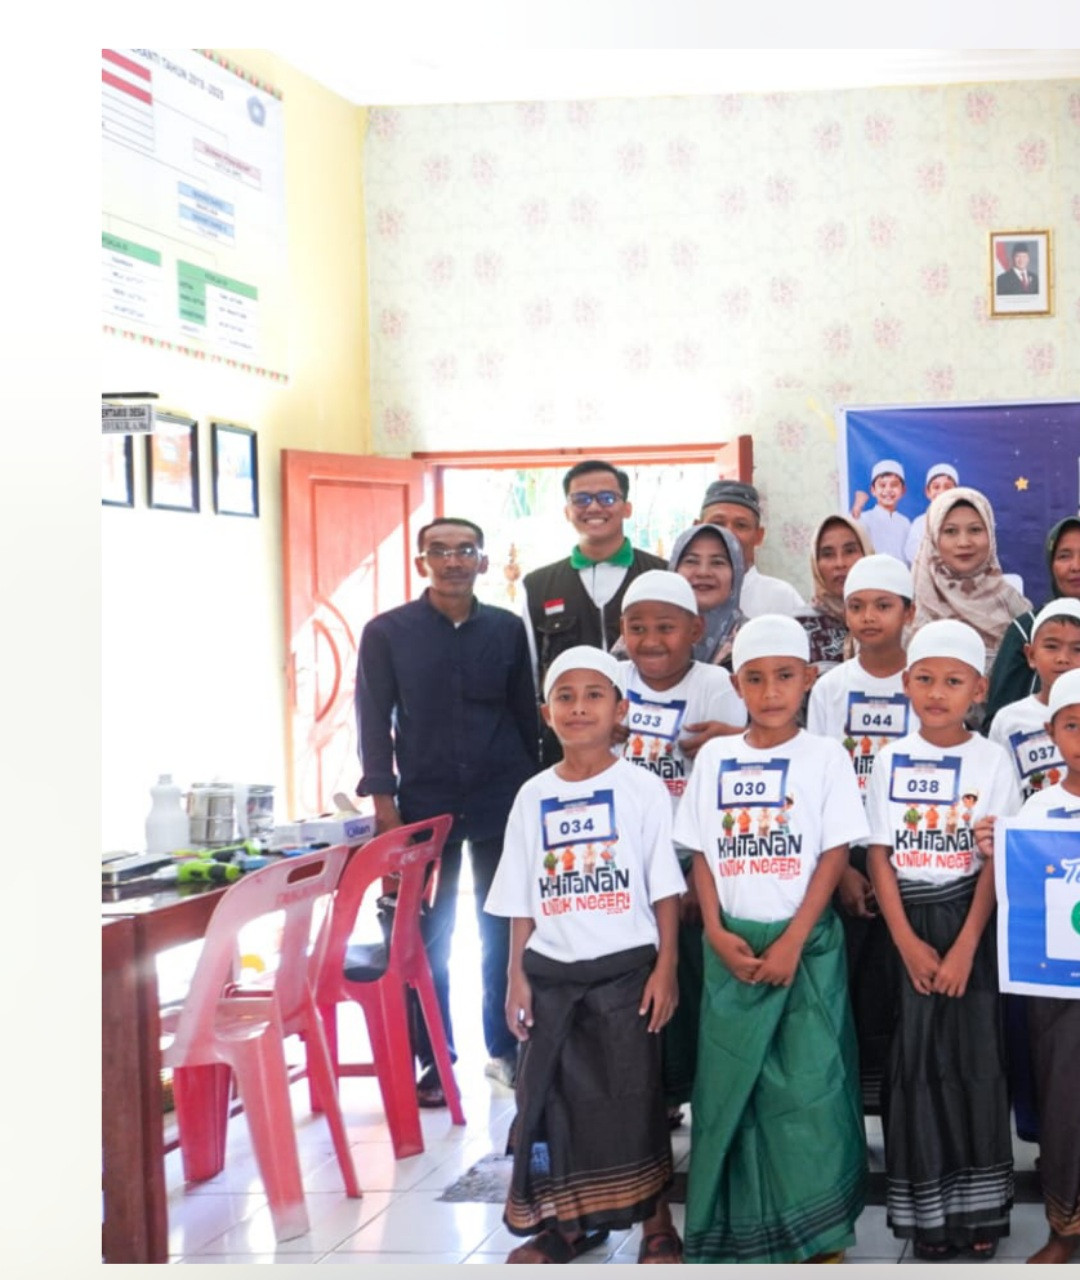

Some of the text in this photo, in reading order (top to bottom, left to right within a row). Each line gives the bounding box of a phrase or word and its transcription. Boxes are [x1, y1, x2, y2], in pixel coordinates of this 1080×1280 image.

[632, 713, 662, 727] 033
[862, 713, 892, 726] 044
[733, 781, 766, 796] 030
[907, 780, 939, 793] 038
[560, 818, 594, 835] 034
